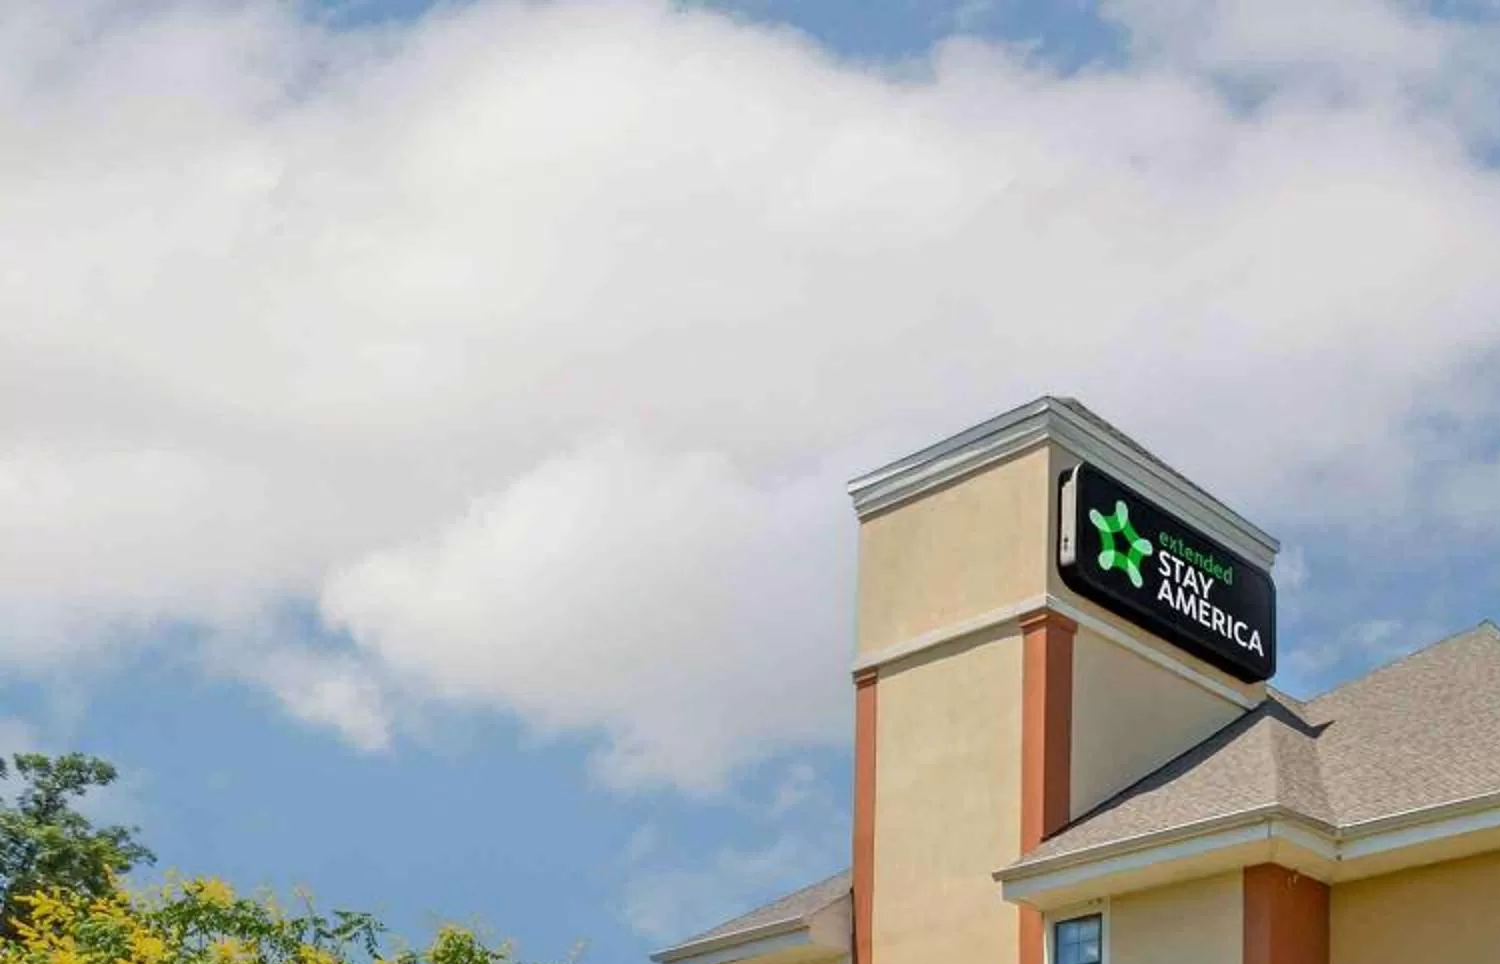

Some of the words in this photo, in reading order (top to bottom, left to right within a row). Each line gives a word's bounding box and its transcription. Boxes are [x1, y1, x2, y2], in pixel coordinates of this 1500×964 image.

[1158, 551, 1214, 599] STAY
[1159, 532, 1233, 585] extended
[1158, 580, 1264, 657] AMERICA
